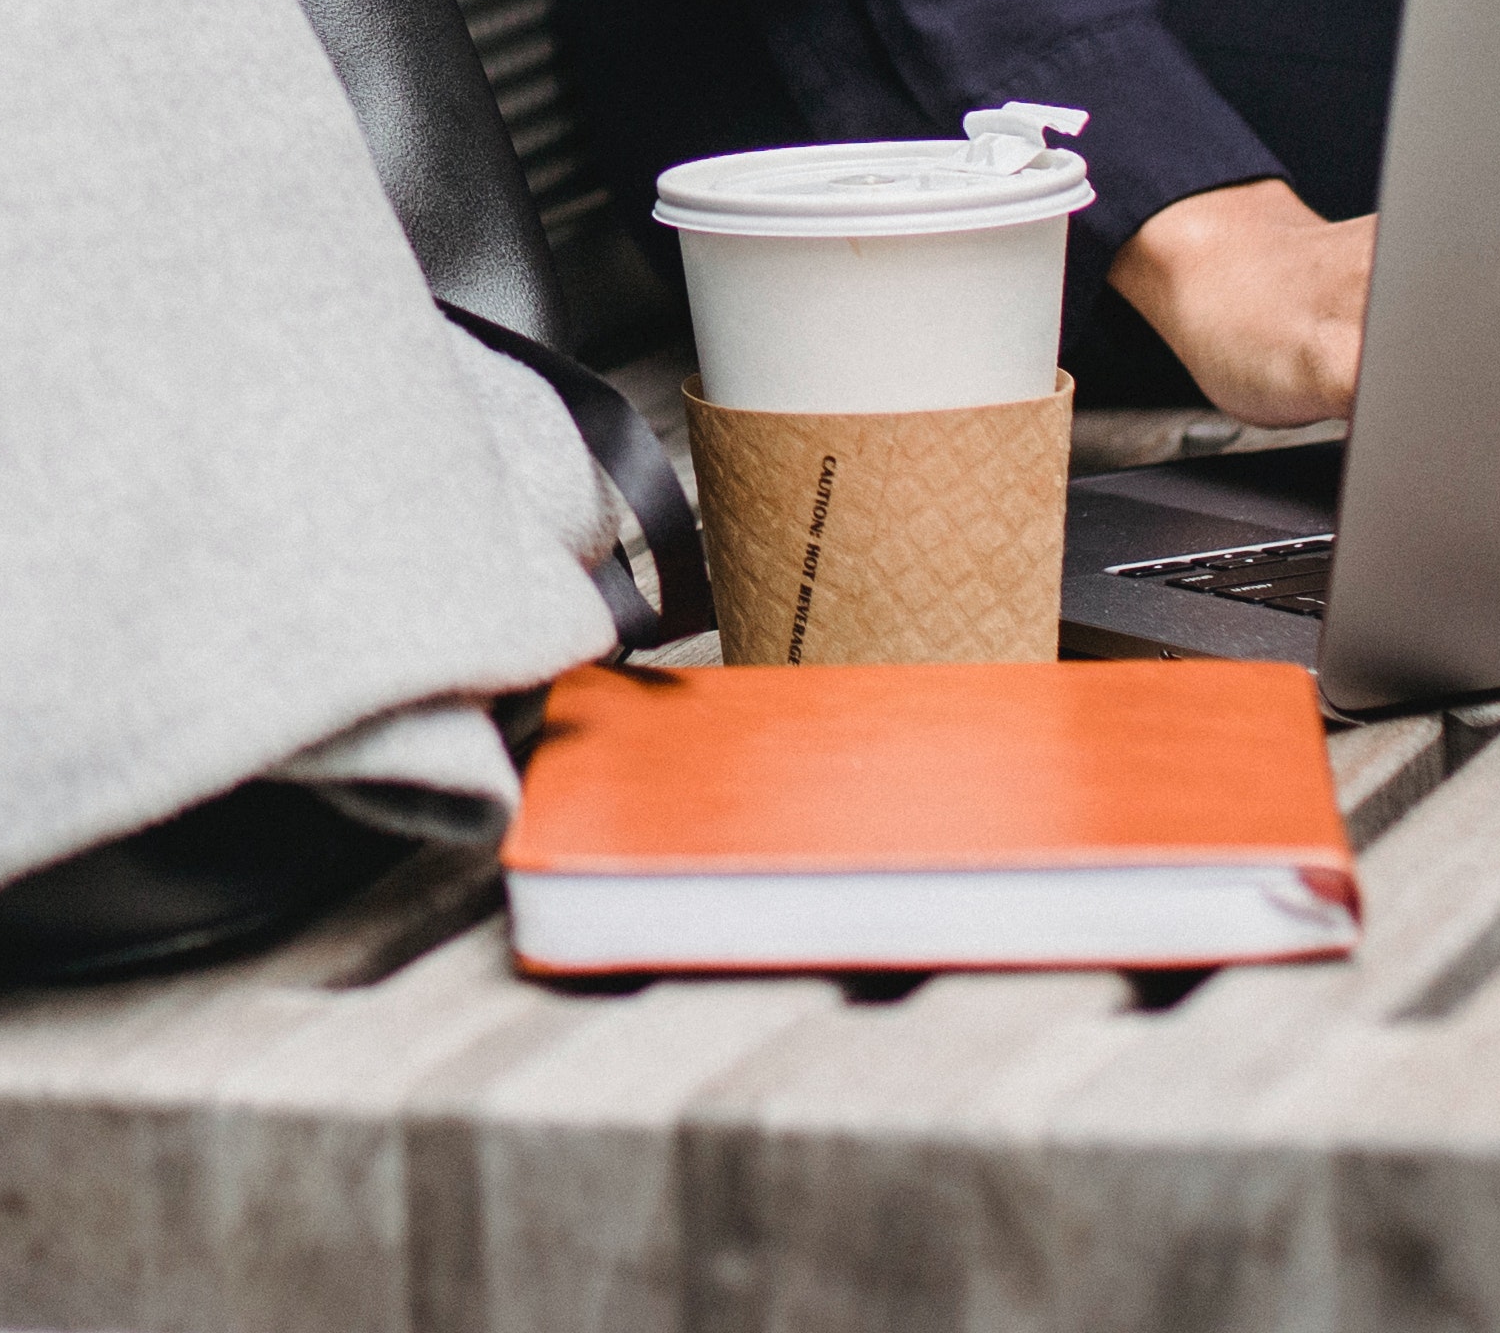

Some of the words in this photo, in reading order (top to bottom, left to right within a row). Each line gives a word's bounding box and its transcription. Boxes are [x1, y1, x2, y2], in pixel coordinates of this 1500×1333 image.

[809, 455, 837, 539] CAUTION:
[802, 543, 821, 582] HOT
[787, 583, 813, 666] BEVERAGE
